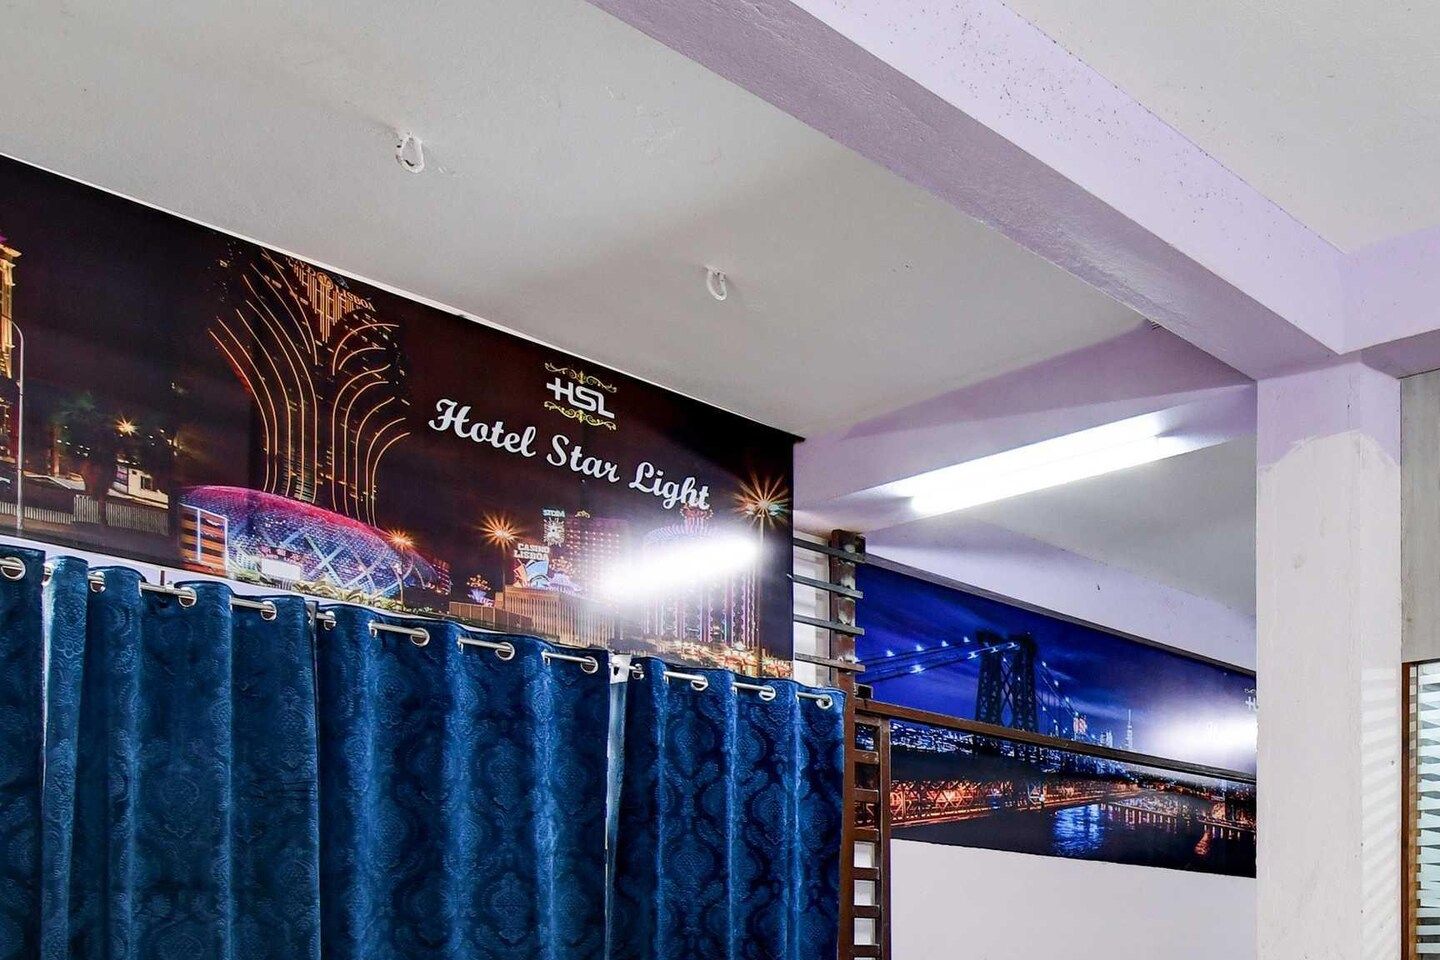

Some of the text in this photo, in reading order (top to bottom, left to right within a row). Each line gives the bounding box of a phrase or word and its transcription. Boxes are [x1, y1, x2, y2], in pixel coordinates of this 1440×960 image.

[546, 377, 615, 419] HSL
[428, 398, 710, 510] Hotel Star Light
